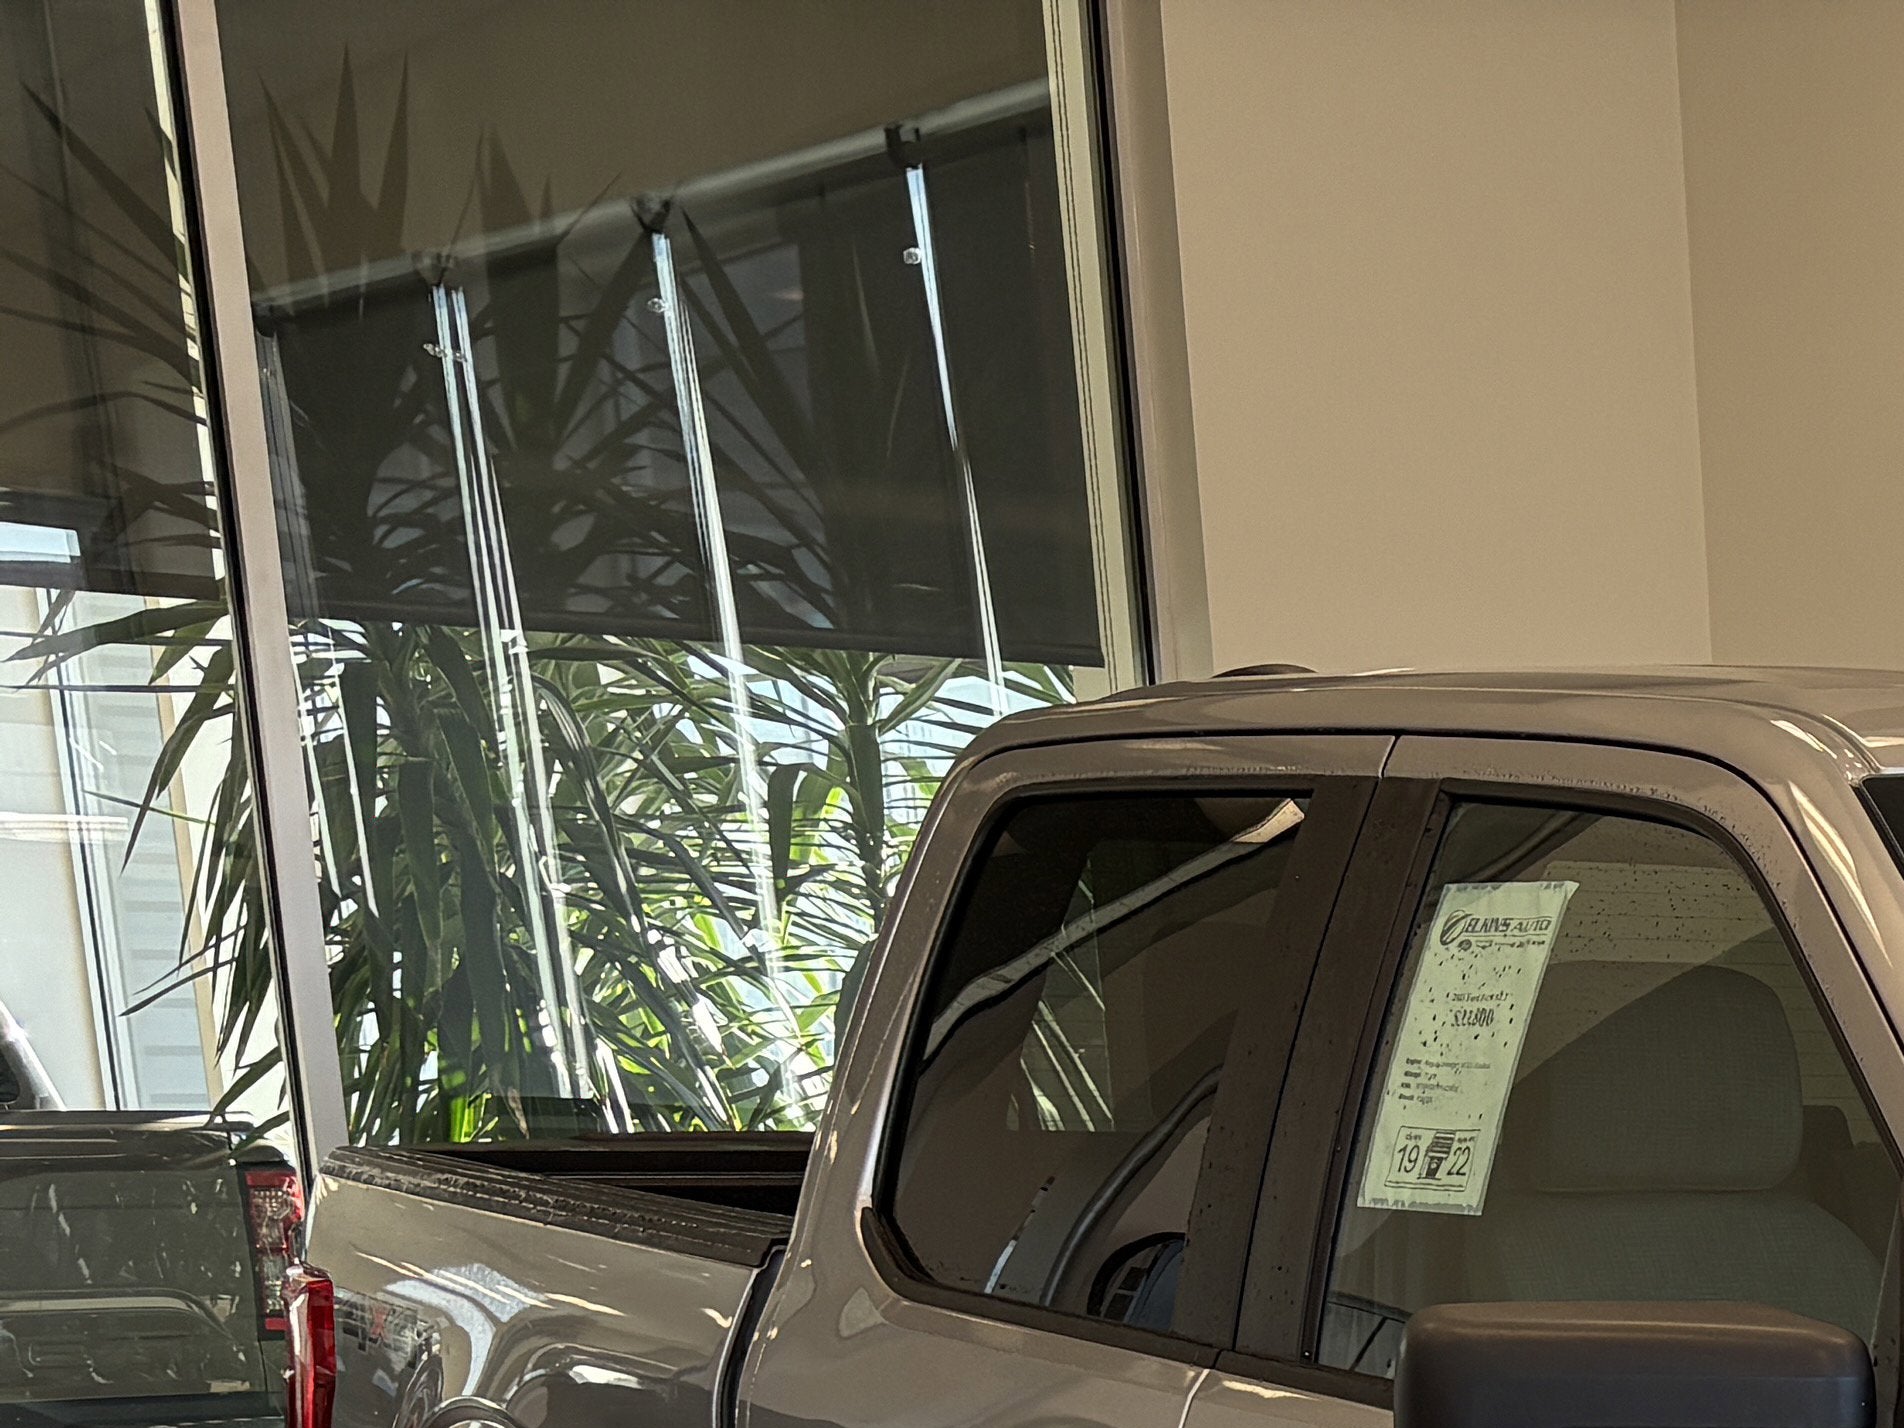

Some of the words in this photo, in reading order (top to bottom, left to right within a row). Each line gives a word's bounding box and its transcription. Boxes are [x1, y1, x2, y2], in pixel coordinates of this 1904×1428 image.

[1465, 917, 1512, 933] ELKINS
[1511, 918, 1552, 933] AUTO
[1397, 1143, 1420, 1173] 19
[1446, 1145, 1471, 1176] 22
